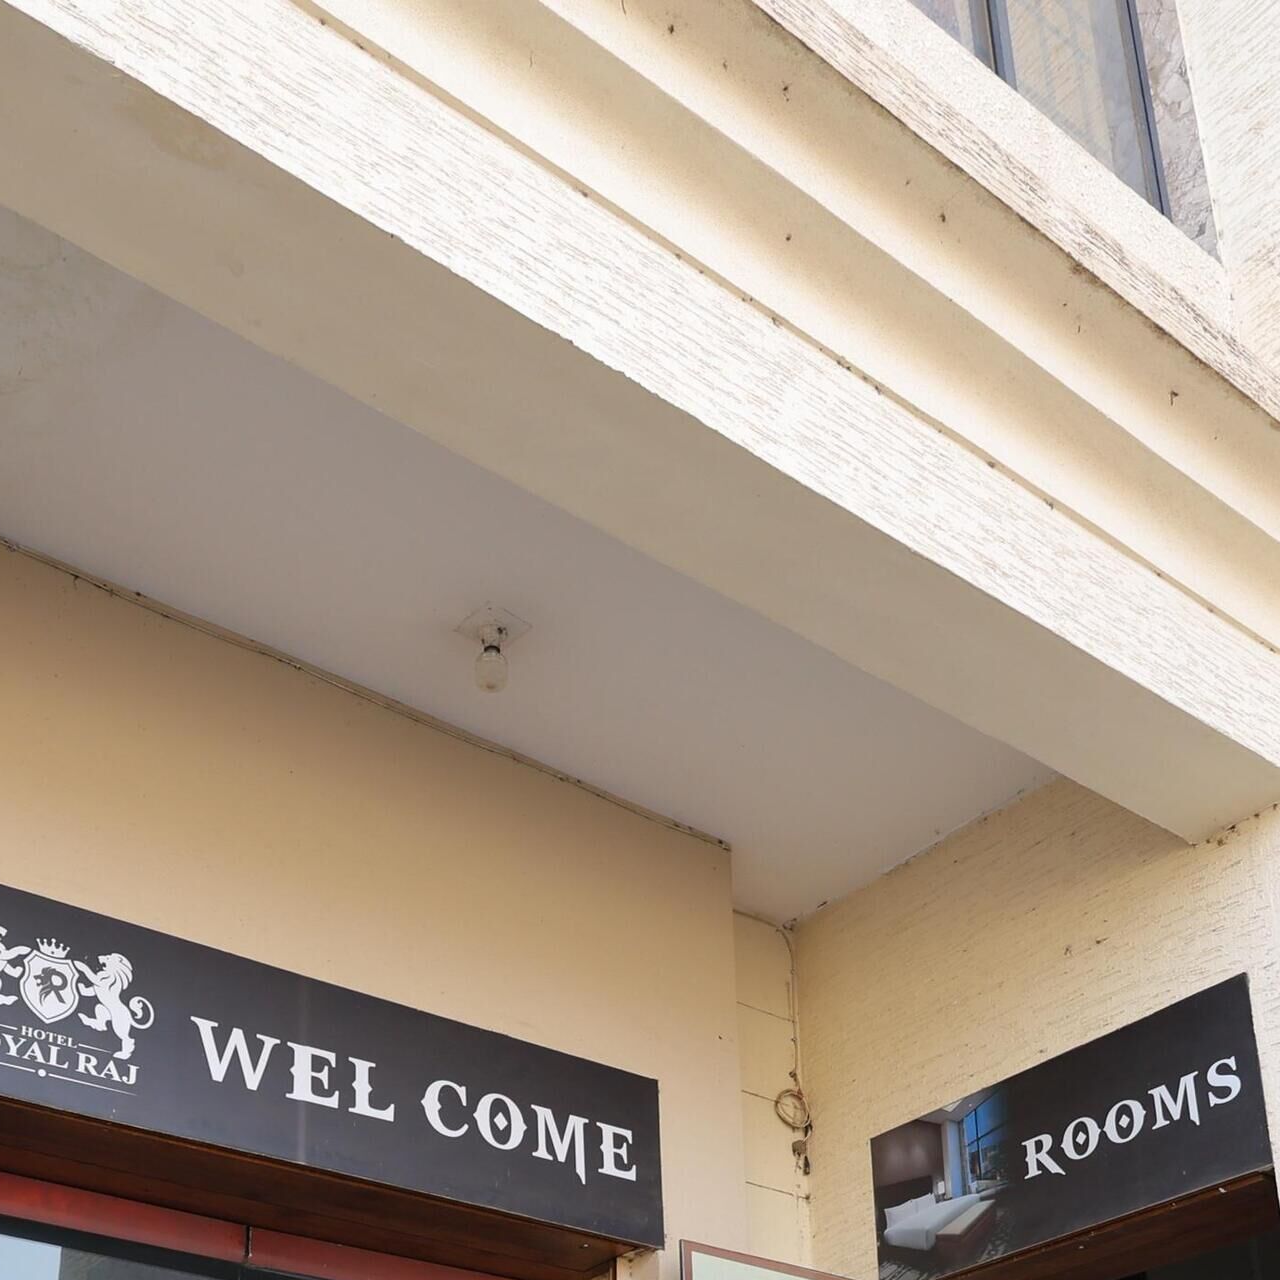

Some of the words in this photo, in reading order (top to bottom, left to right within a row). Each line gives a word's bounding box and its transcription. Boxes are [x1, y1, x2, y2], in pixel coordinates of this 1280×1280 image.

[22, 1025, 77, 1049] HOTEL
[75, 1051, 140, 1085] RAJ
[190, 1015, 396, 1122] WEL
[420, 1079, 638, 1185] COME
[1021, 1055, 1242, 1180] ROOMS
